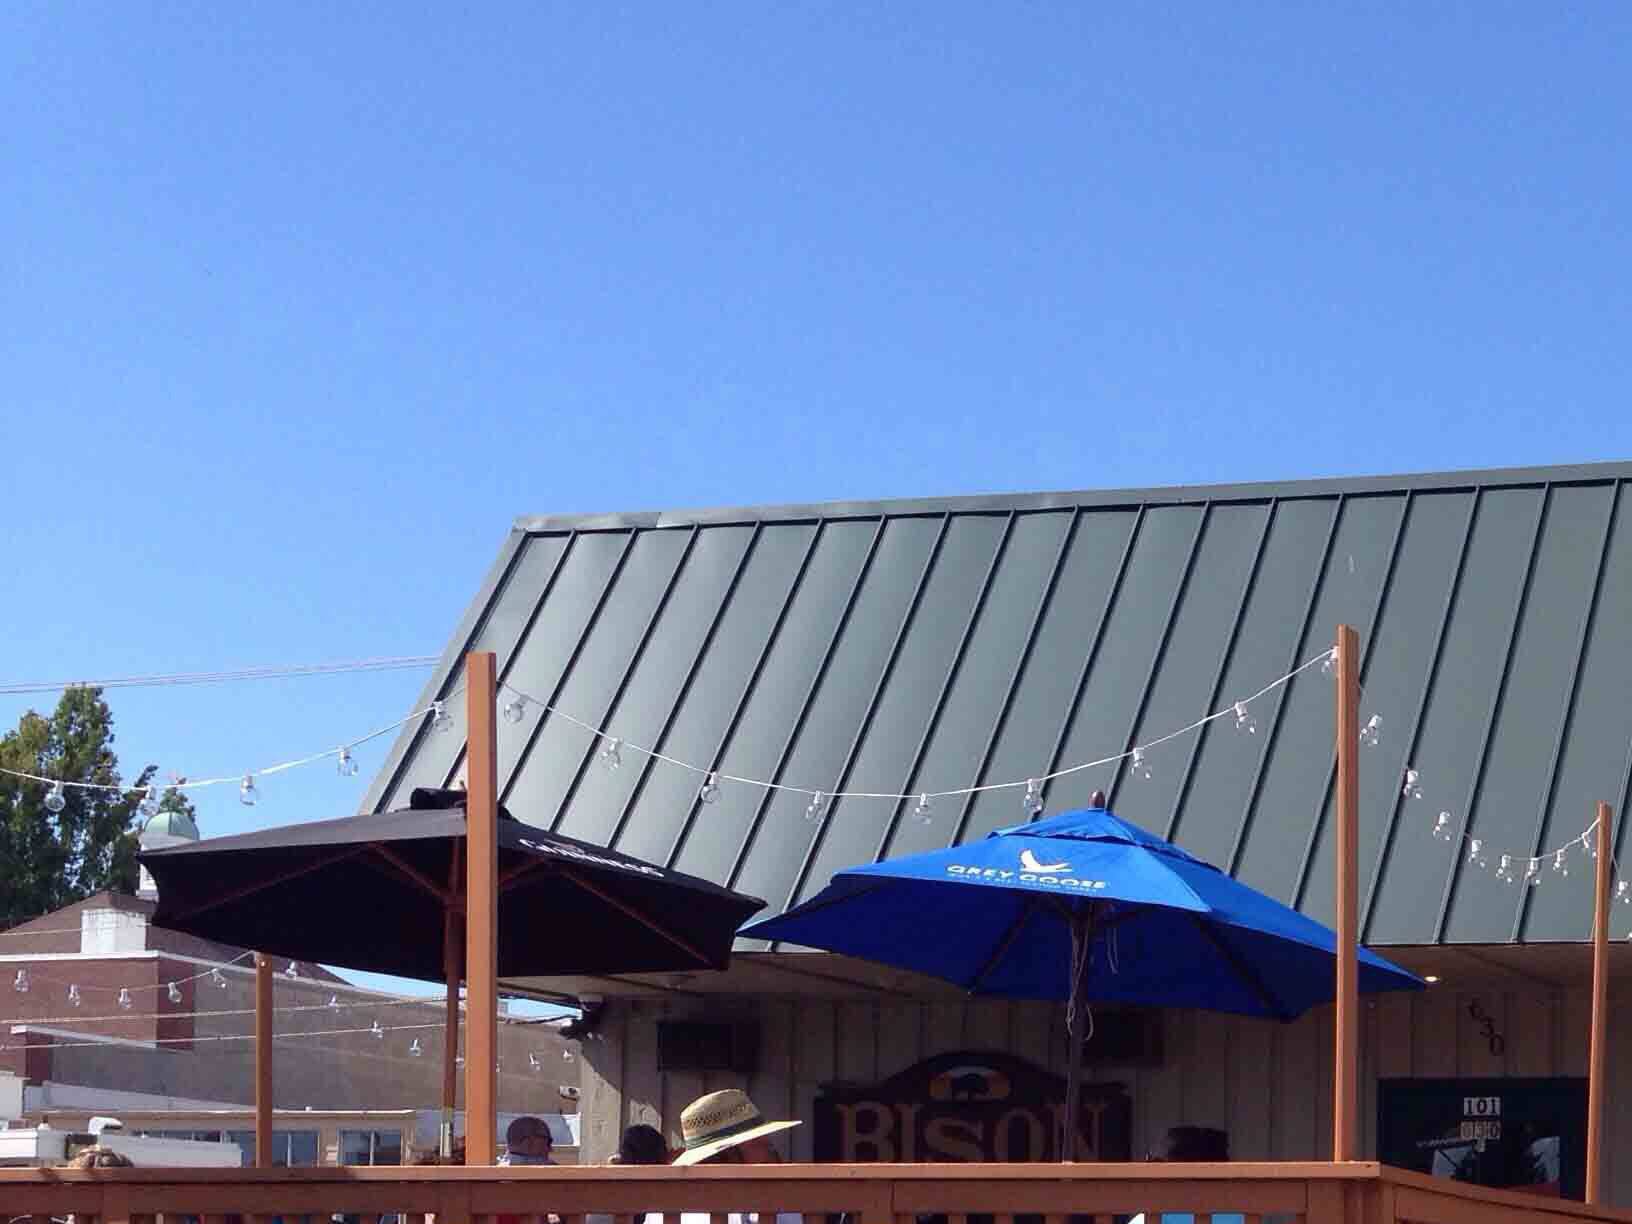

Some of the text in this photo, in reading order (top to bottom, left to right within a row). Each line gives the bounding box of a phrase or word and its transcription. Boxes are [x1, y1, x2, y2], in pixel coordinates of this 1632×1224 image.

[1018, 873, 1107, 889] GOOSE
[1466, 1098, 1498, 1115] 101
[834, 1102, 1109, 1163] BISON
